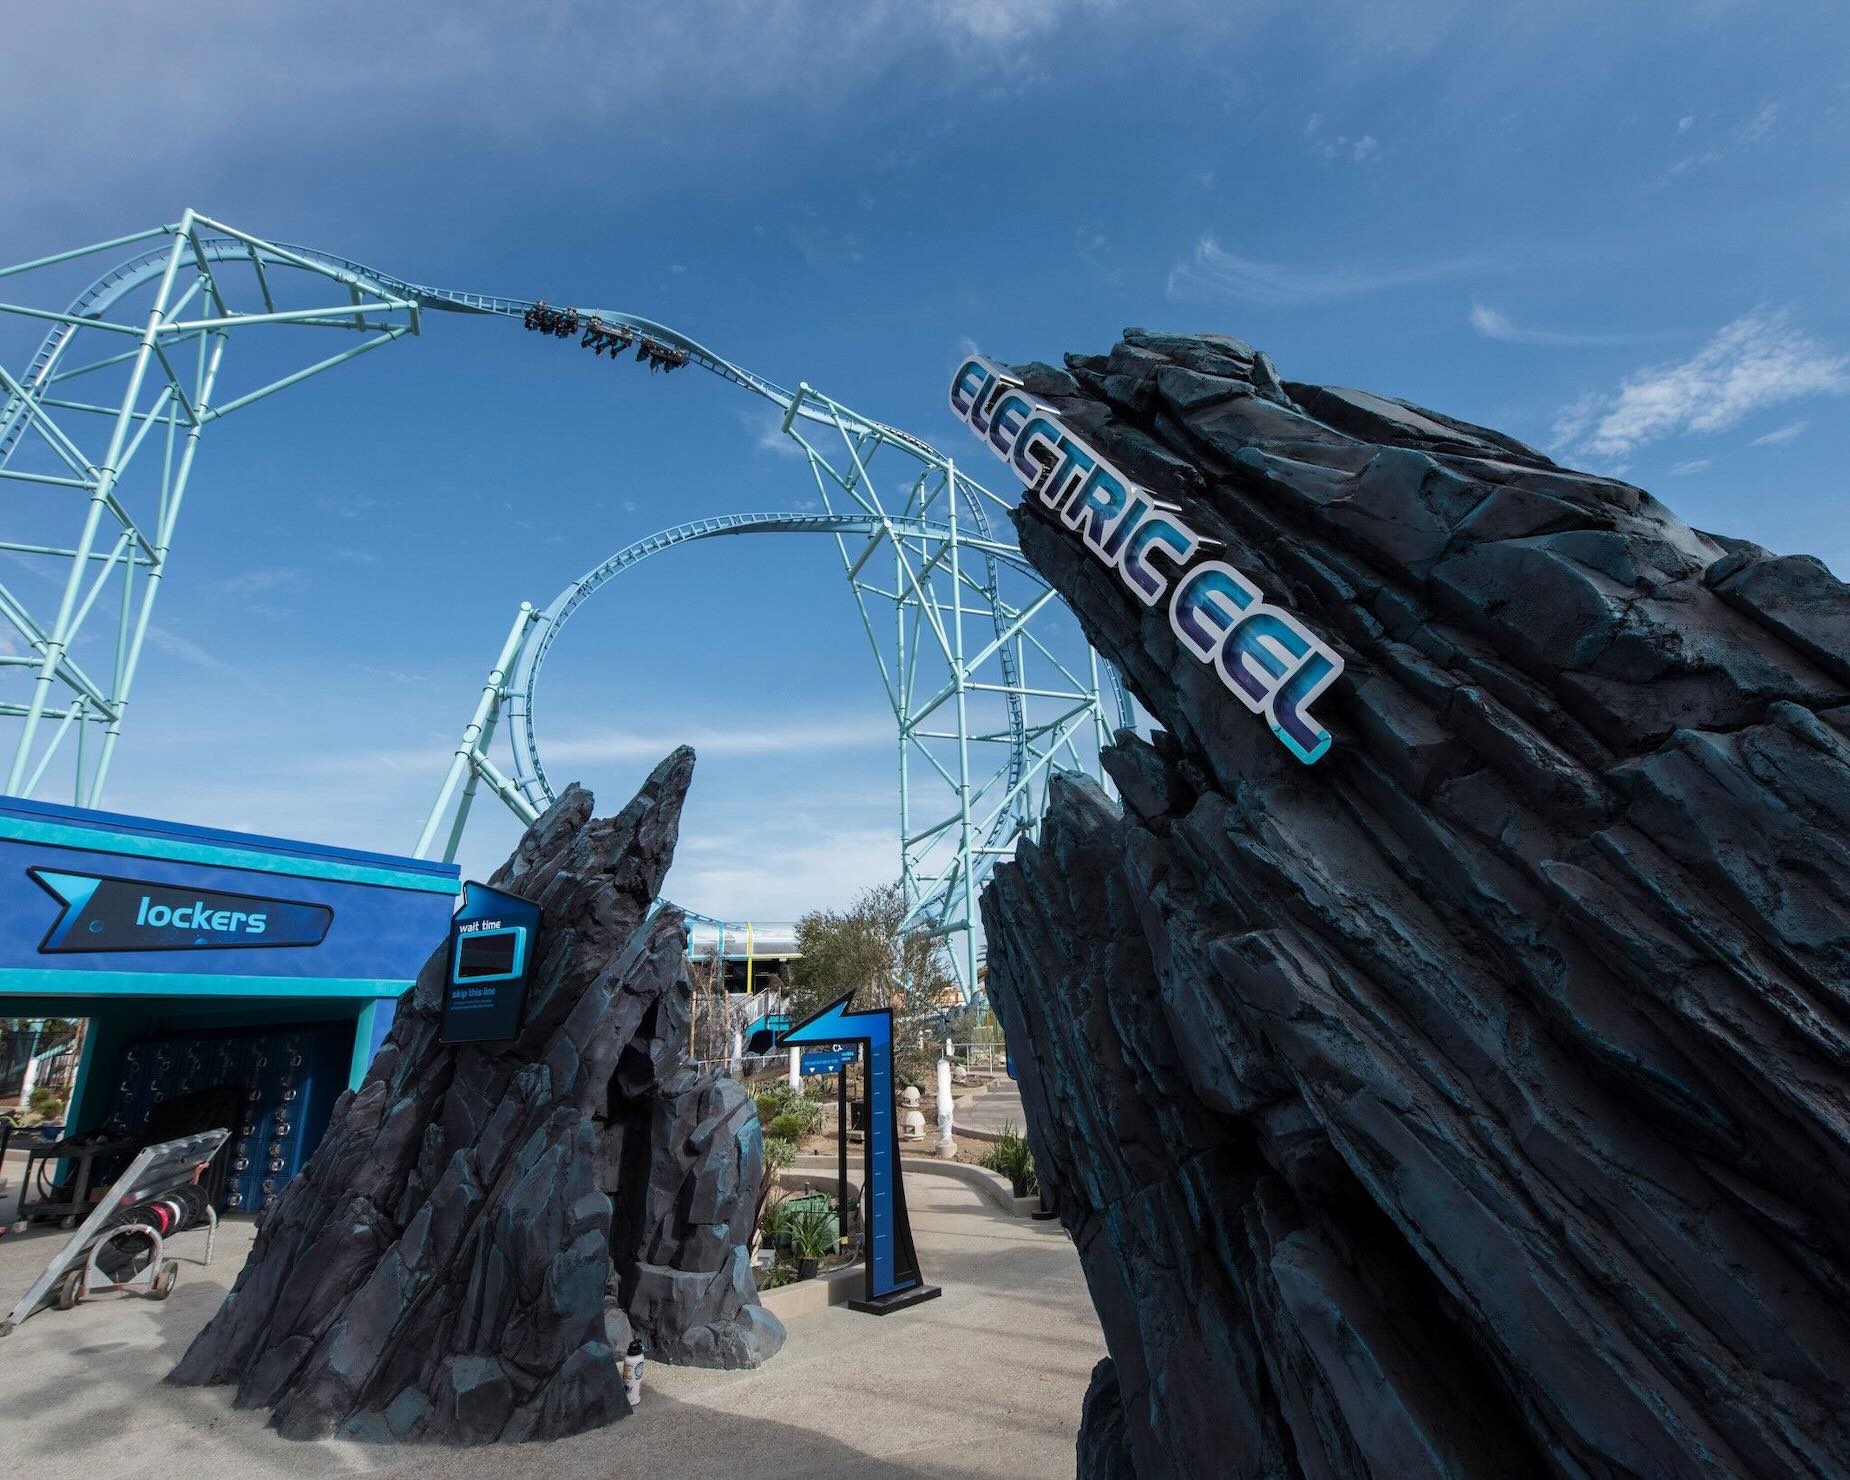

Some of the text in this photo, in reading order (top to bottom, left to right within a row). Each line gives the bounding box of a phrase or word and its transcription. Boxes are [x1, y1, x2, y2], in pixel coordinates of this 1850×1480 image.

[950, 356, 1343, 762] ELECTRIC EEL
[136, 896, 267, 934] lockers
[459, 919, 501, 933] wait time
